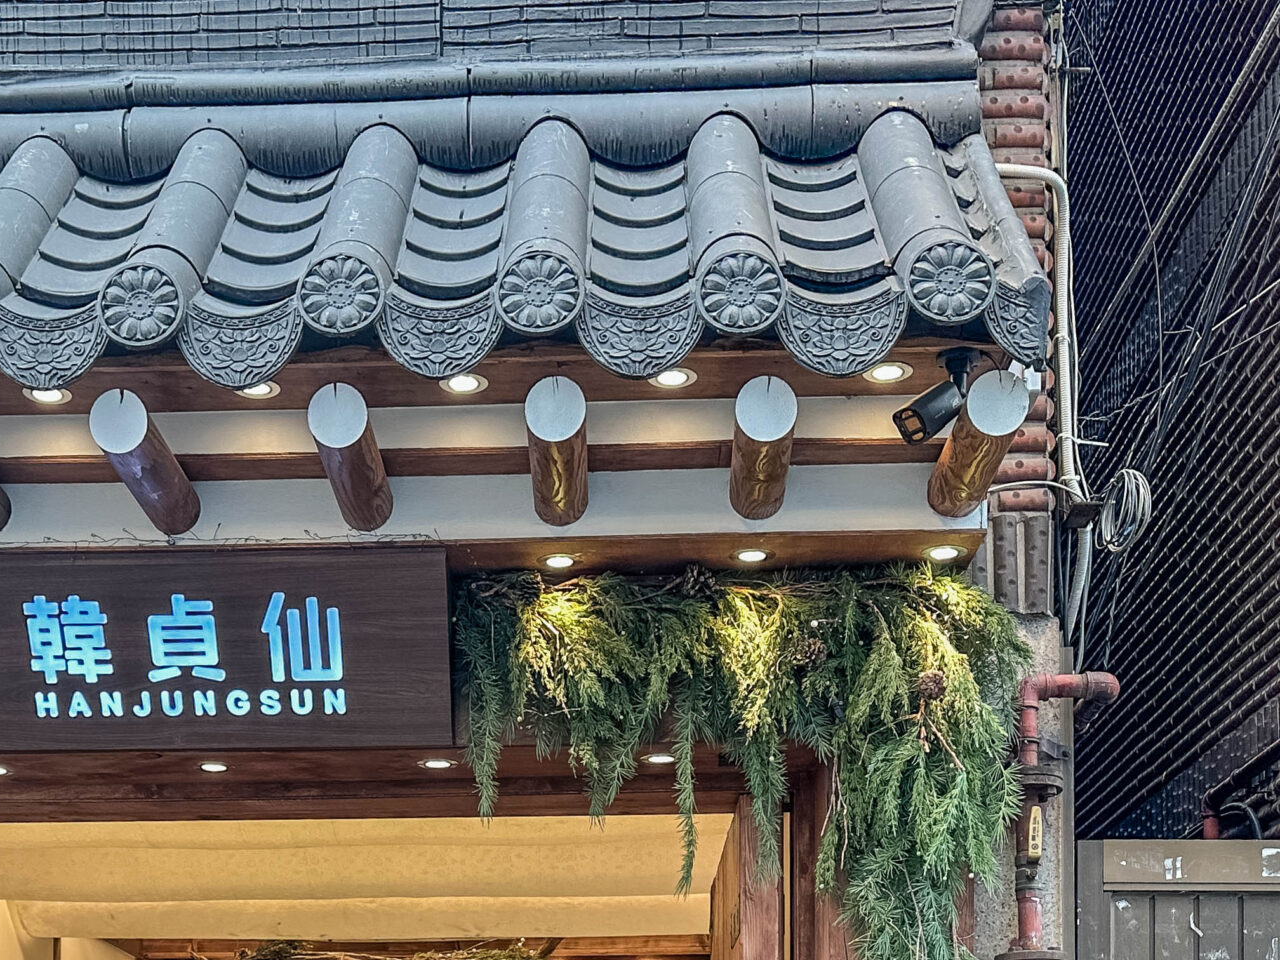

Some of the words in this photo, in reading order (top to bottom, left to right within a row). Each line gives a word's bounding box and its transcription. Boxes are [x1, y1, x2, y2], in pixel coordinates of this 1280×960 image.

[22, 591, 344, 685] 韓貞仙
[34, 687, 348, 718] HANJUNGSUN
